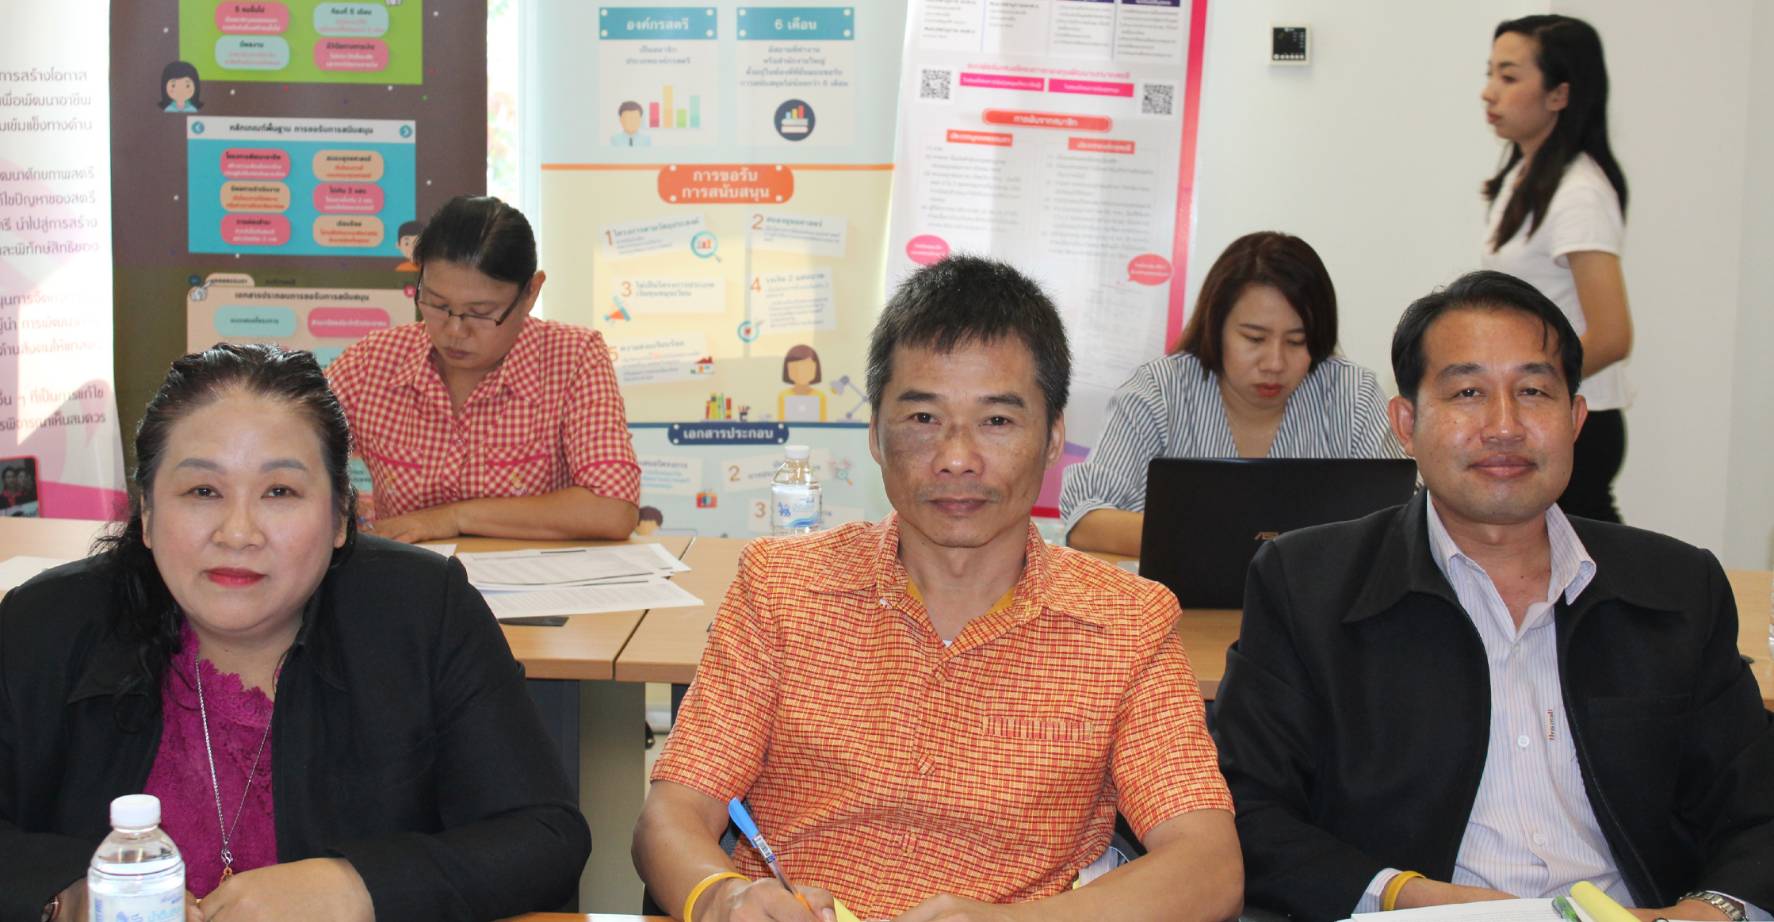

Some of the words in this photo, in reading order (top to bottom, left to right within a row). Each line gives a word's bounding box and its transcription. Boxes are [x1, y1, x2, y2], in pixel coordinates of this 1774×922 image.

[626, 16, 689, 31] องค์กรสตรี
[774, 17, 783, 31] 6
[788, 16, 817, 31] เดือน
[693, 167, 758, 182] การขอรับ
[682, 183, 770, 202] การสนับสนุน
[752, 213, 765, 231] 2
[605, 230, 613, 246] 1
[620, 281, 633, 299] 3
[749, 276, 762, 293] 4
[683, 427, 774, 441] เอกสารประกอบ
[728, 464, 741, 482] 2
[754, 502, 767, 518] 3
